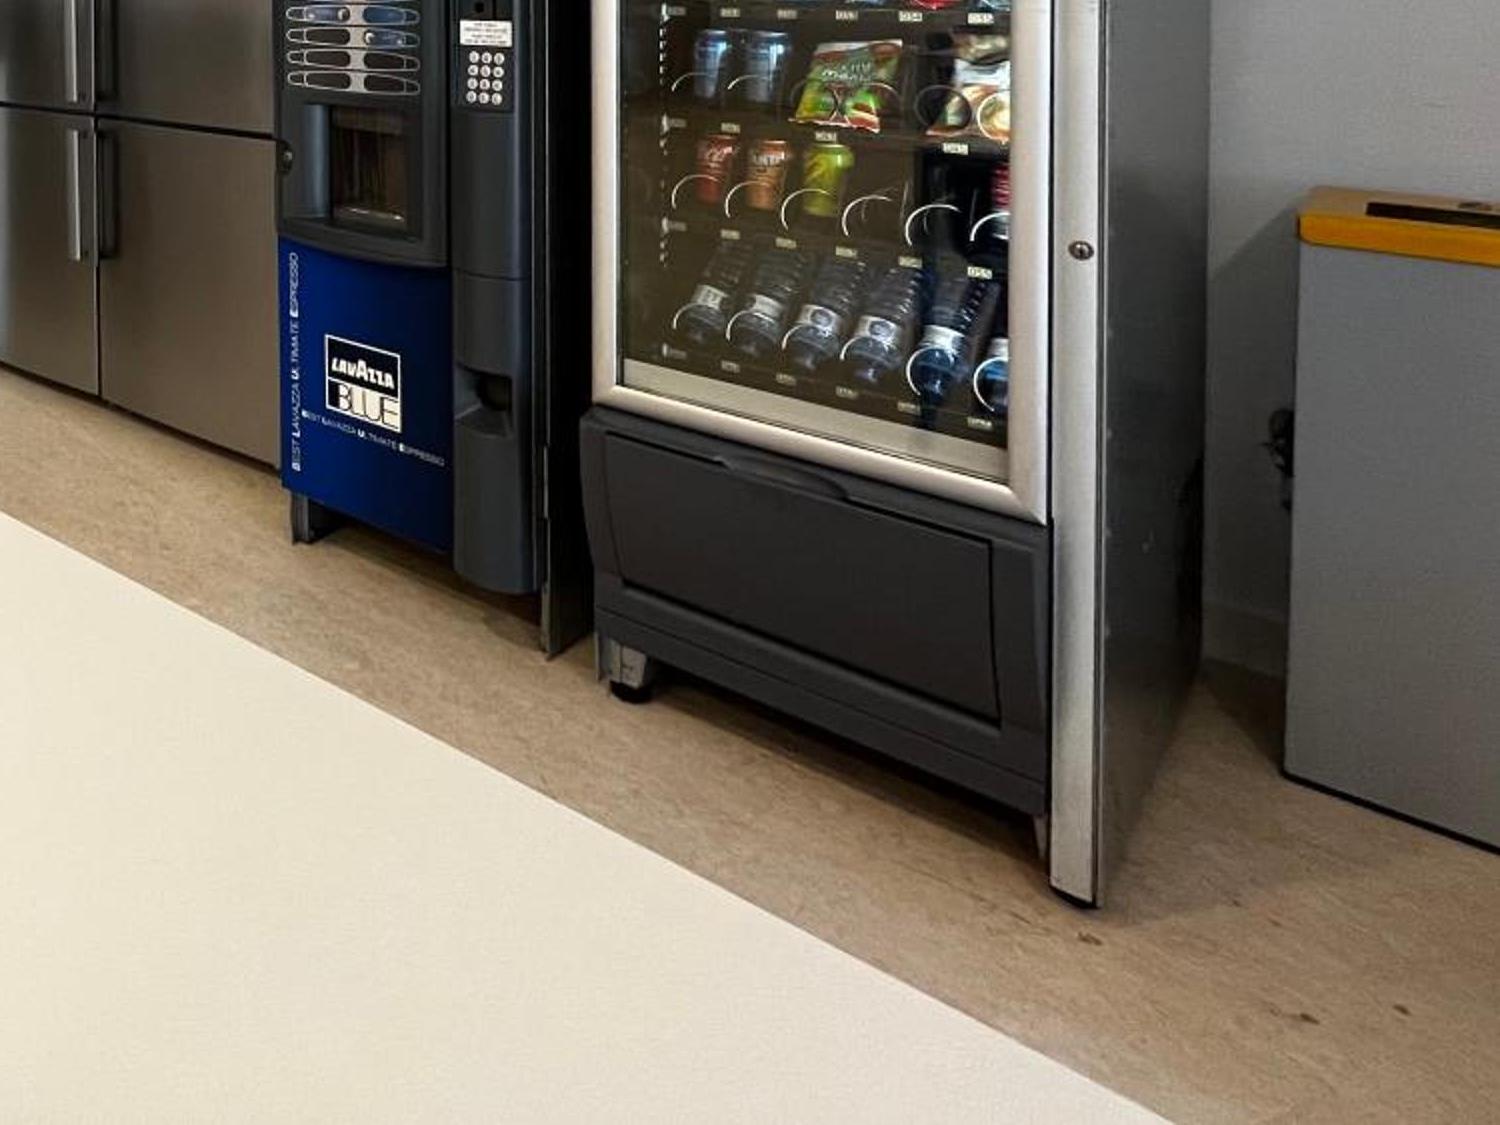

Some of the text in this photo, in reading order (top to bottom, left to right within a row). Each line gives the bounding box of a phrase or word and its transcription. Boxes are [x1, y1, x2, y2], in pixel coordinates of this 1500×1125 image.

[289, 252, 299, 318] ESPRESSO
[331, 357, 395, 390] LAVAZZA
[336, 381, 399, 431] BLUE
